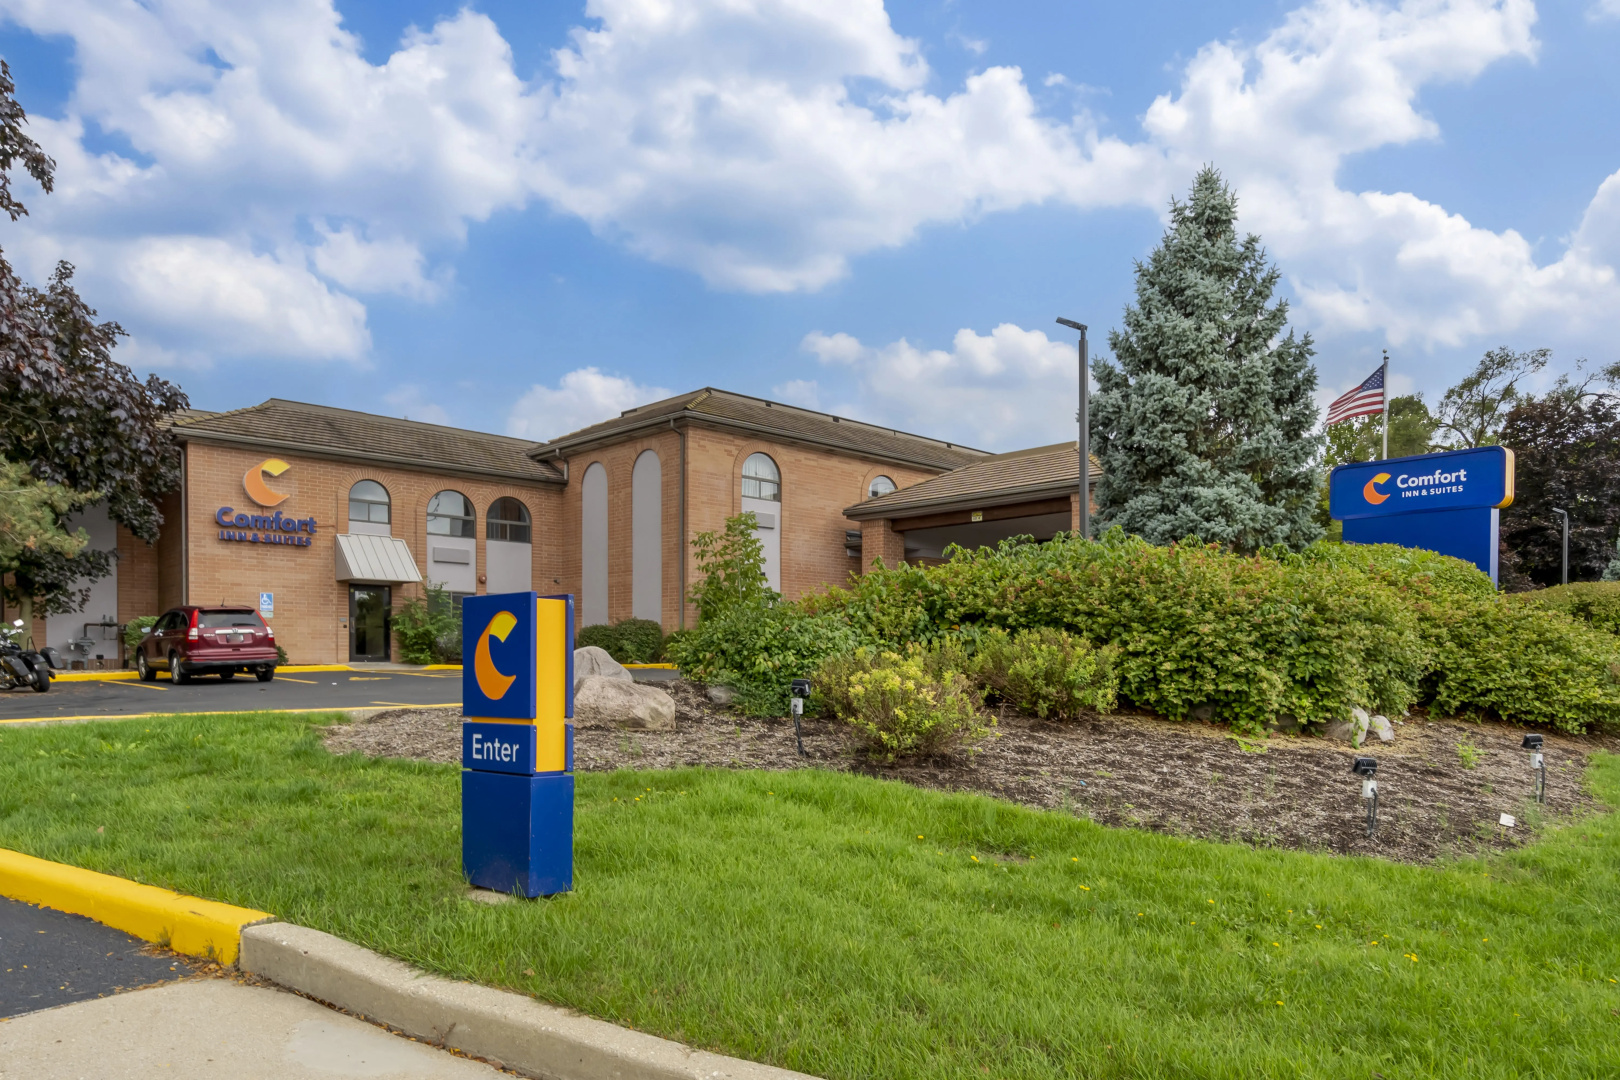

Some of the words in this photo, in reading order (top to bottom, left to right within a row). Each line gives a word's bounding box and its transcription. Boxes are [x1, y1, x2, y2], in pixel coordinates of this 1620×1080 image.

[1396, 469, 1467, 488] Comfort
[1401, 490, 1419, 498] INN
[1430, 485, 1463, 495] SUITES
[216, 506, 317, 533] Comfort
[219, 530, 246, 541] INN
[250, 532, 260, 542] &
[264, 534, 312, 546] SUITES
[472, 733, 520, 763] Enter
